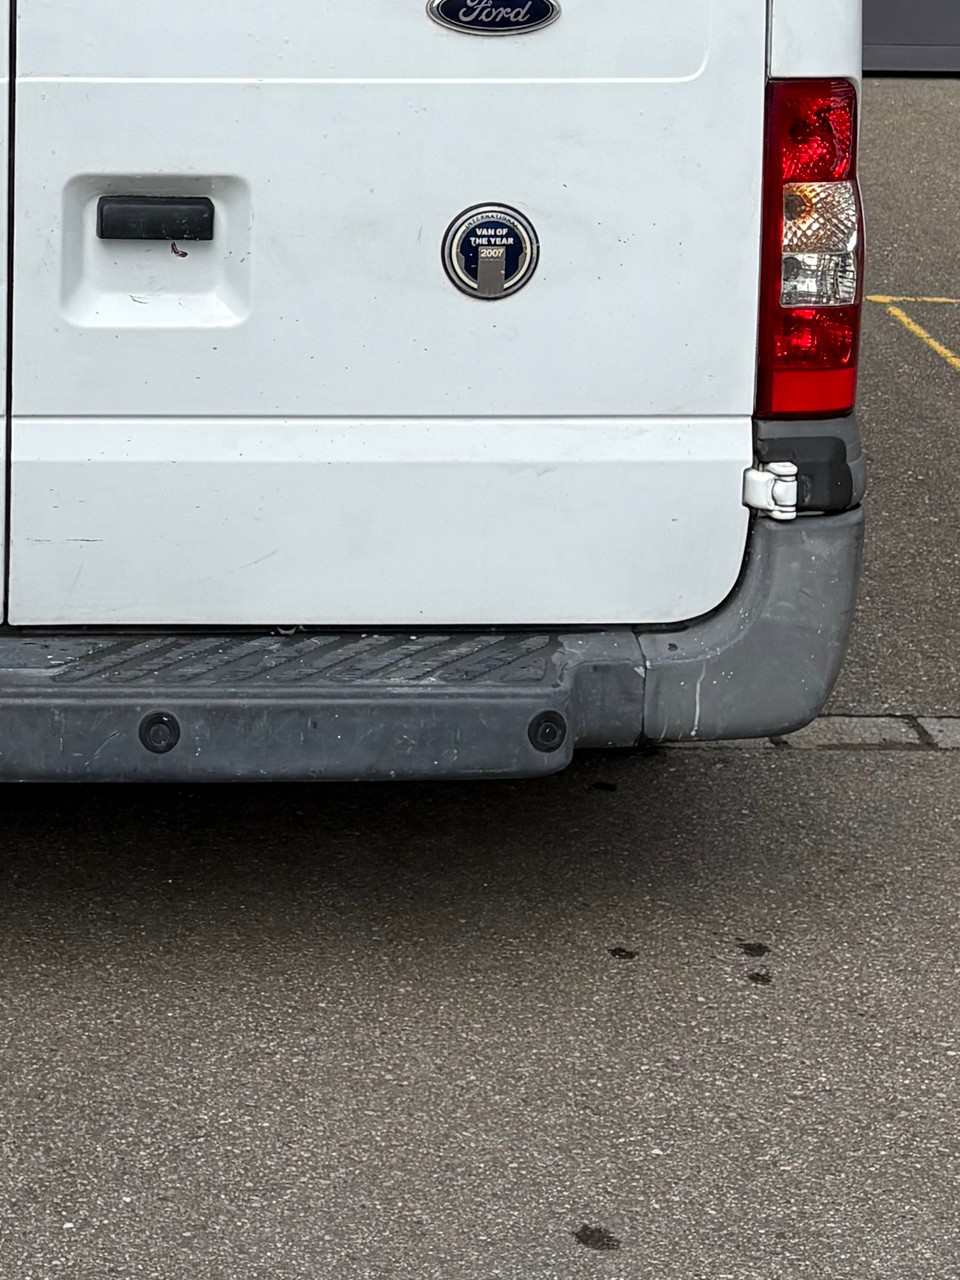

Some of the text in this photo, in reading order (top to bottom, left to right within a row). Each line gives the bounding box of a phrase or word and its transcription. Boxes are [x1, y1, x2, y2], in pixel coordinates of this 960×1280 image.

[475, 228, 508, 236] VAN OF
[470, 237, 514, 245] THE YEAR
[480, 249, 504, 257] 2007
